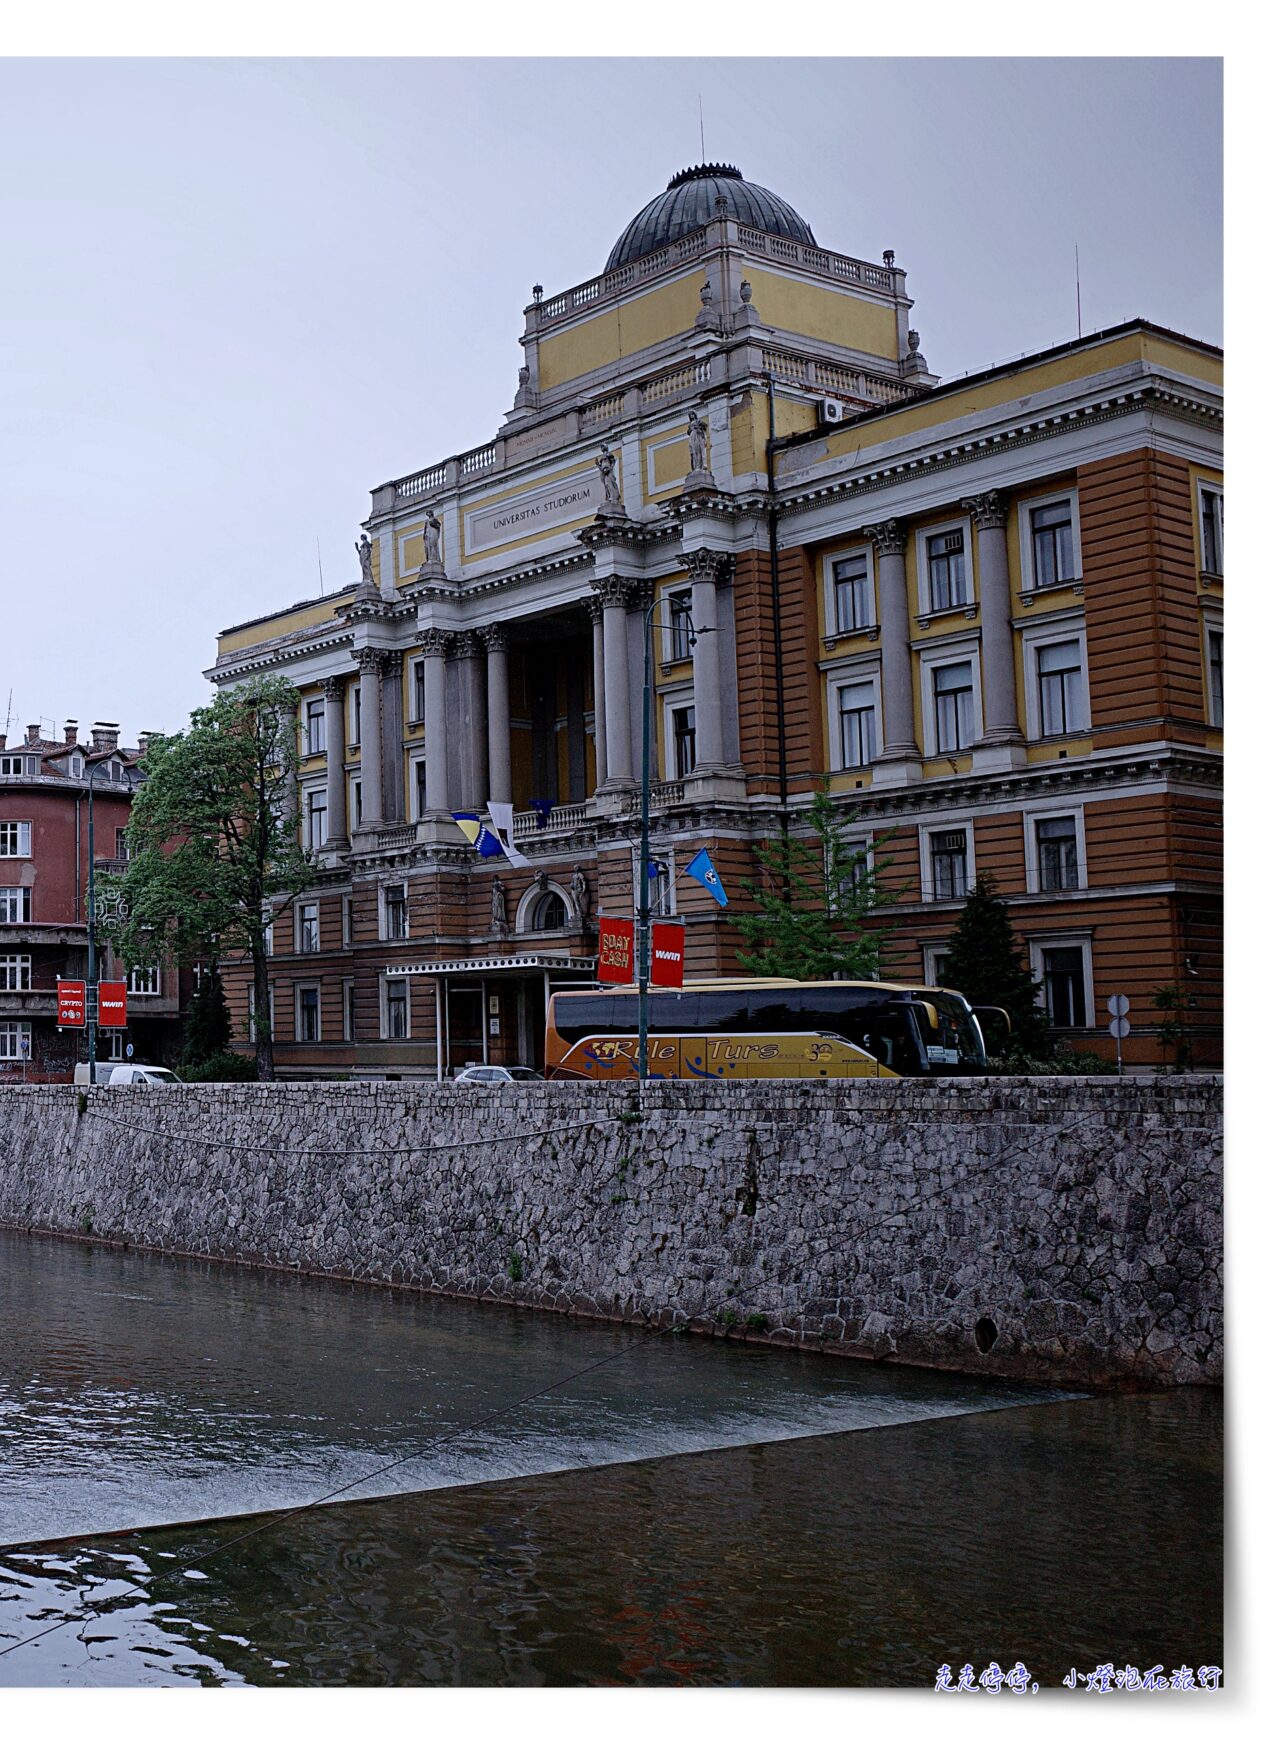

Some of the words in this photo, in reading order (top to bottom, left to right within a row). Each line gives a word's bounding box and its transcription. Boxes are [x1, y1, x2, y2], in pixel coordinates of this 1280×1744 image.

[493, 506, 541, 529] UNIVERSITAS
[543, 488, 591, 512] STUDIORUM
[600, 950, 629, 969] CASH
[708, 1039, 780, 1060] Turs
